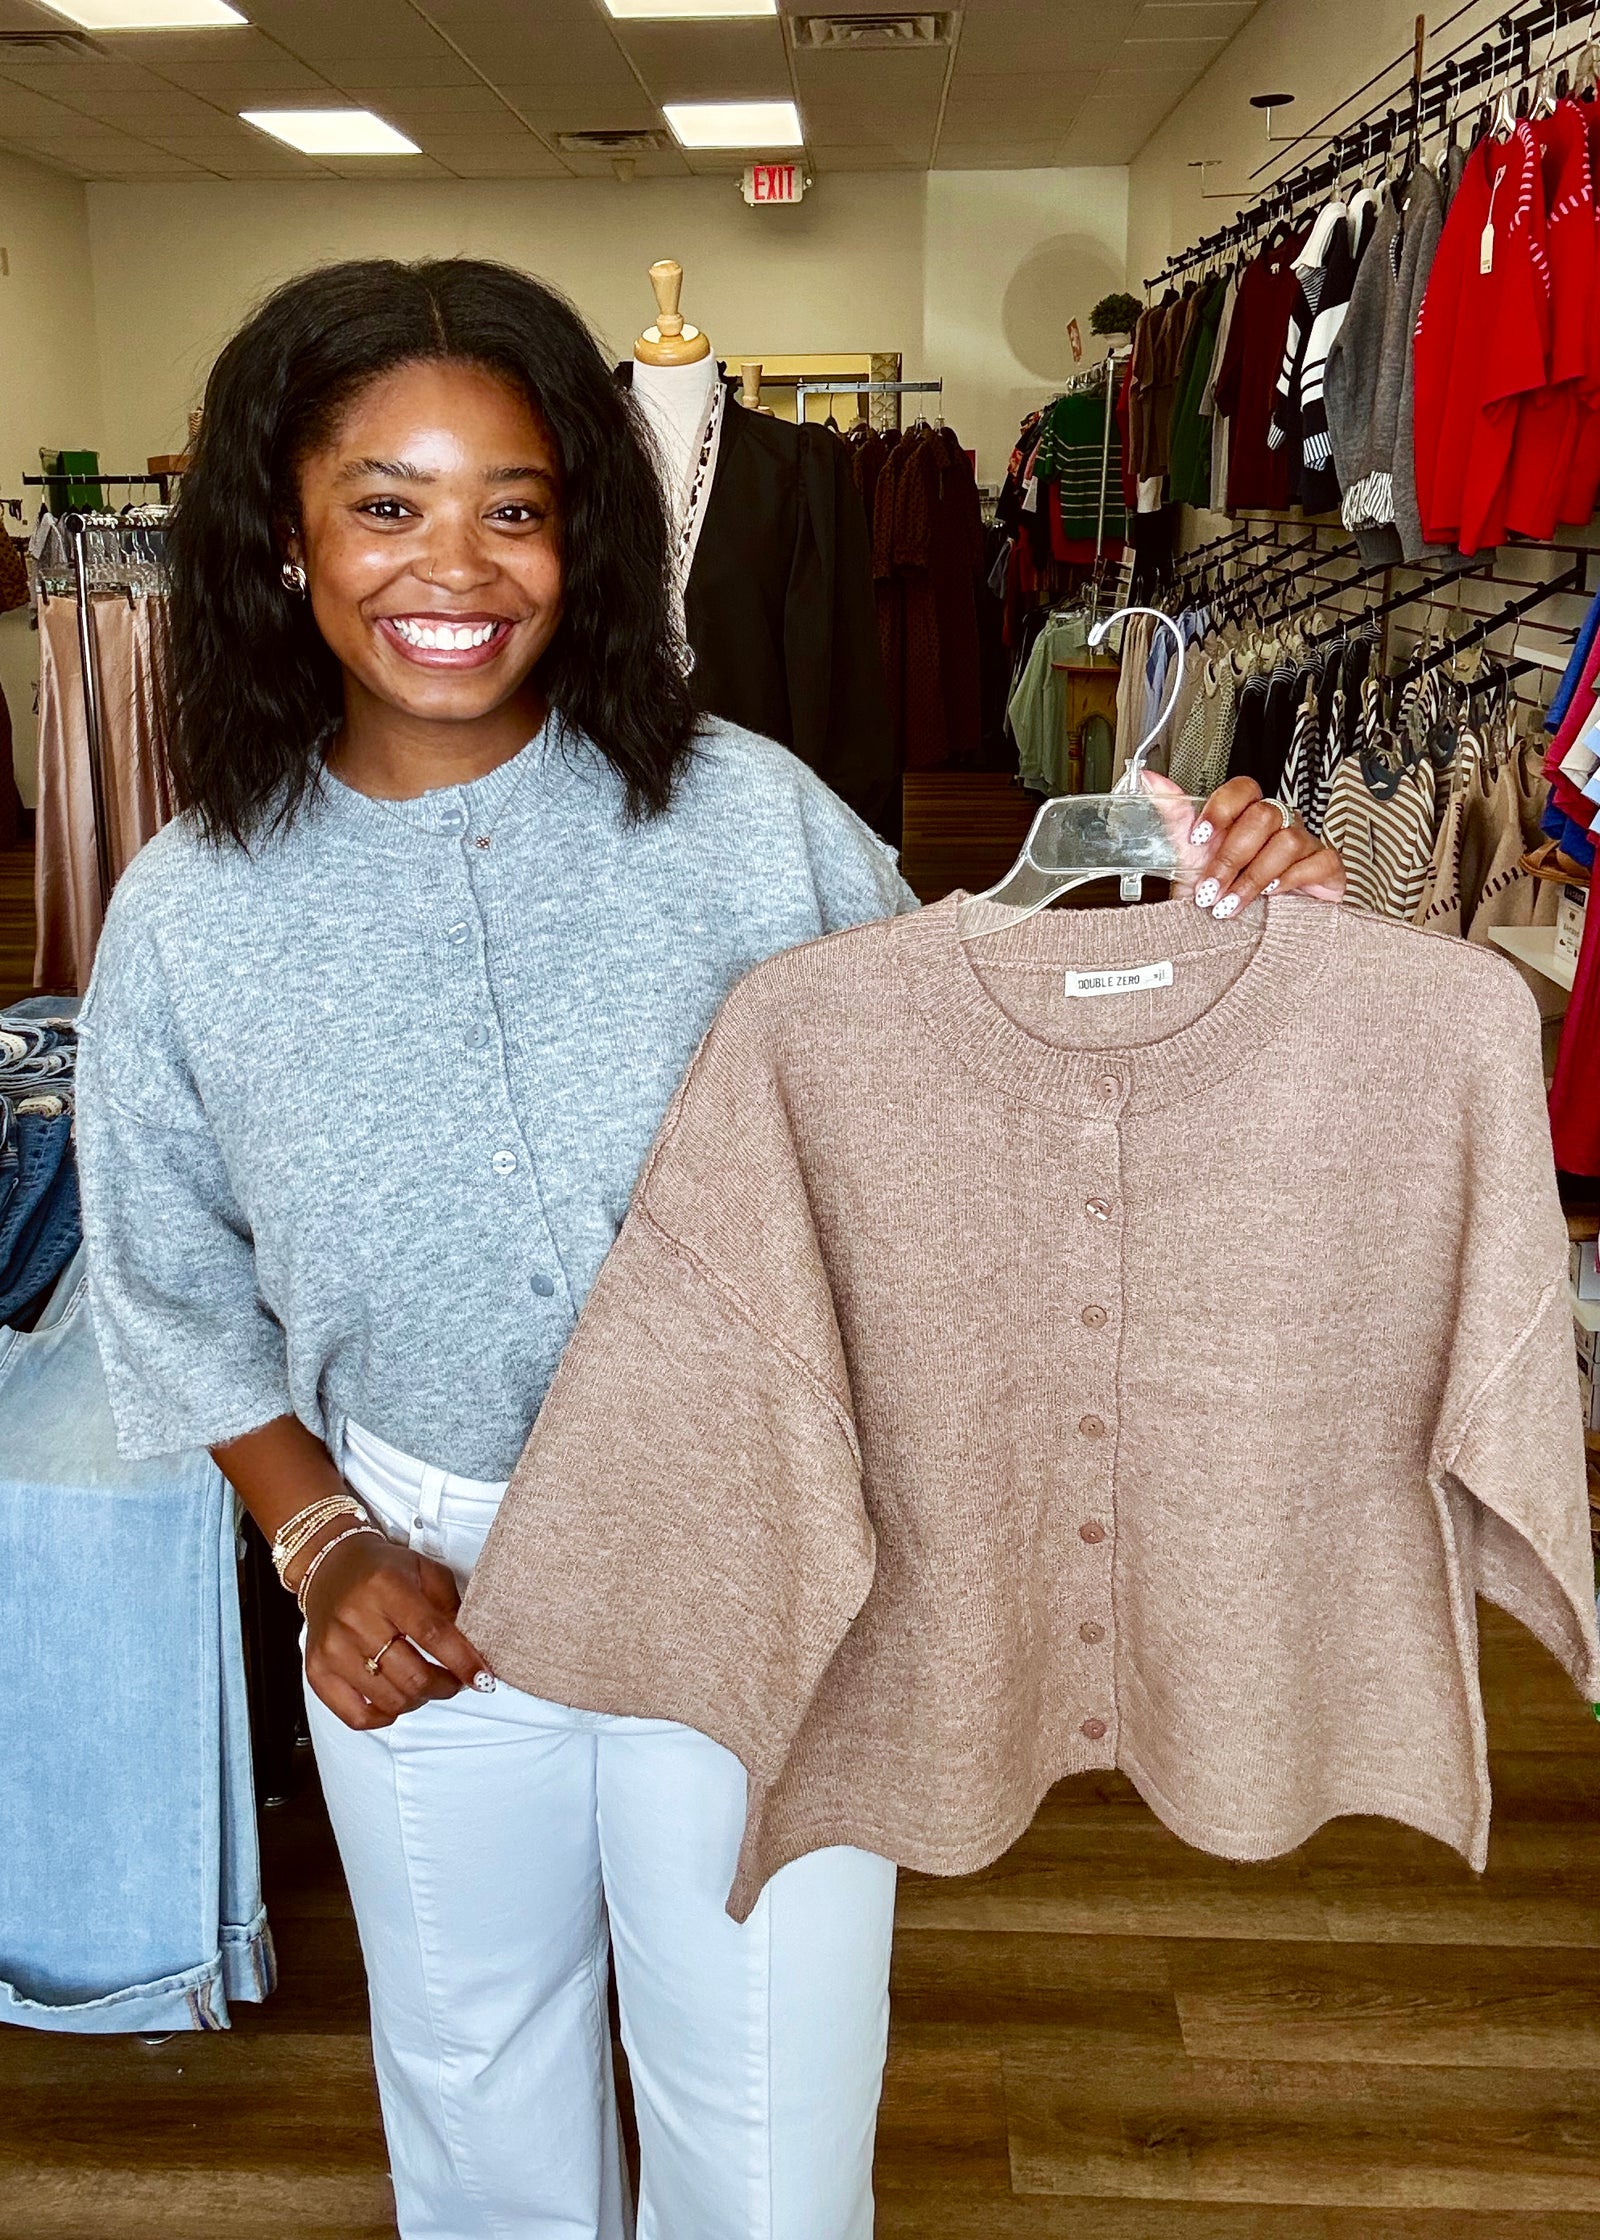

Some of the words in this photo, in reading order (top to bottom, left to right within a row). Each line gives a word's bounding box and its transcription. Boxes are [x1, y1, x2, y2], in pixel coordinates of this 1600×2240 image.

[754, 166, 795, 200] EXIT
[1078, 976, 1114, 990] DOUBLE
[1116, 974, 1140, 987] ZERO
